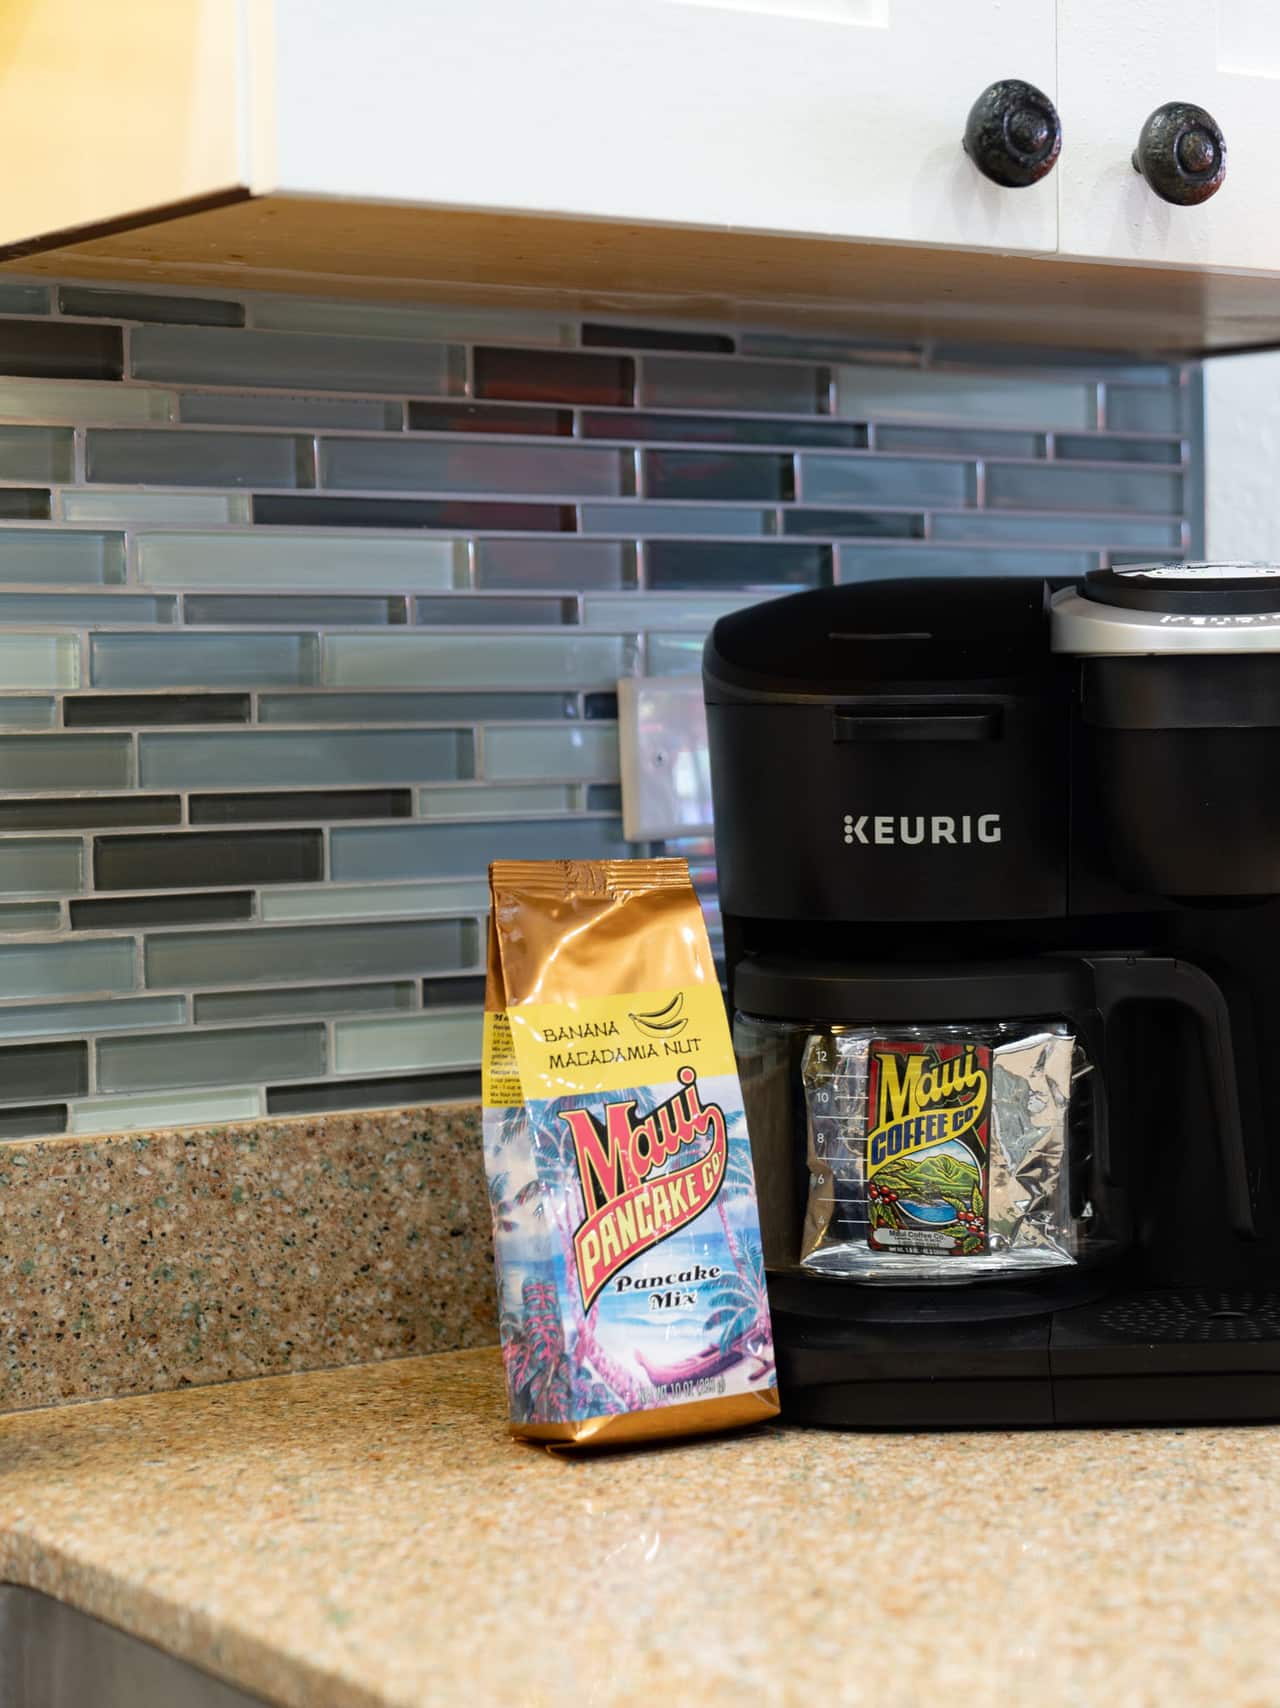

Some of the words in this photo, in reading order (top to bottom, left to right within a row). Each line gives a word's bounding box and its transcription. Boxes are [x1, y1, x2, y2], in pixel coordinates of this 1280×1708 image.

[844, 814, 1001, 845] KEURIG
[543, 1021, 620, 1042] BANANA
[549, 1044, 658, 1069] MACADAMIA
[664, 1038, 701, 1056] NUT
[816, 1050, 828, 1063] 12
[875, 1043, 987, 1125] Maui
[816, 1091, 829, 1103] 10
[558, 1066, 727, 1220] Maui
[816, 1132, 825, 1144] 8
[871, 1113, 948, 1166] COFFEE
[816, 1174, 825, 1185] 6
[580, 1173, 701, 1289] PANCAKE
[908, 1231, 932, 1239] Coffee
[615, 1264, 721, 1293] Pancake
[650, 1291, 697, 1312] Mix
